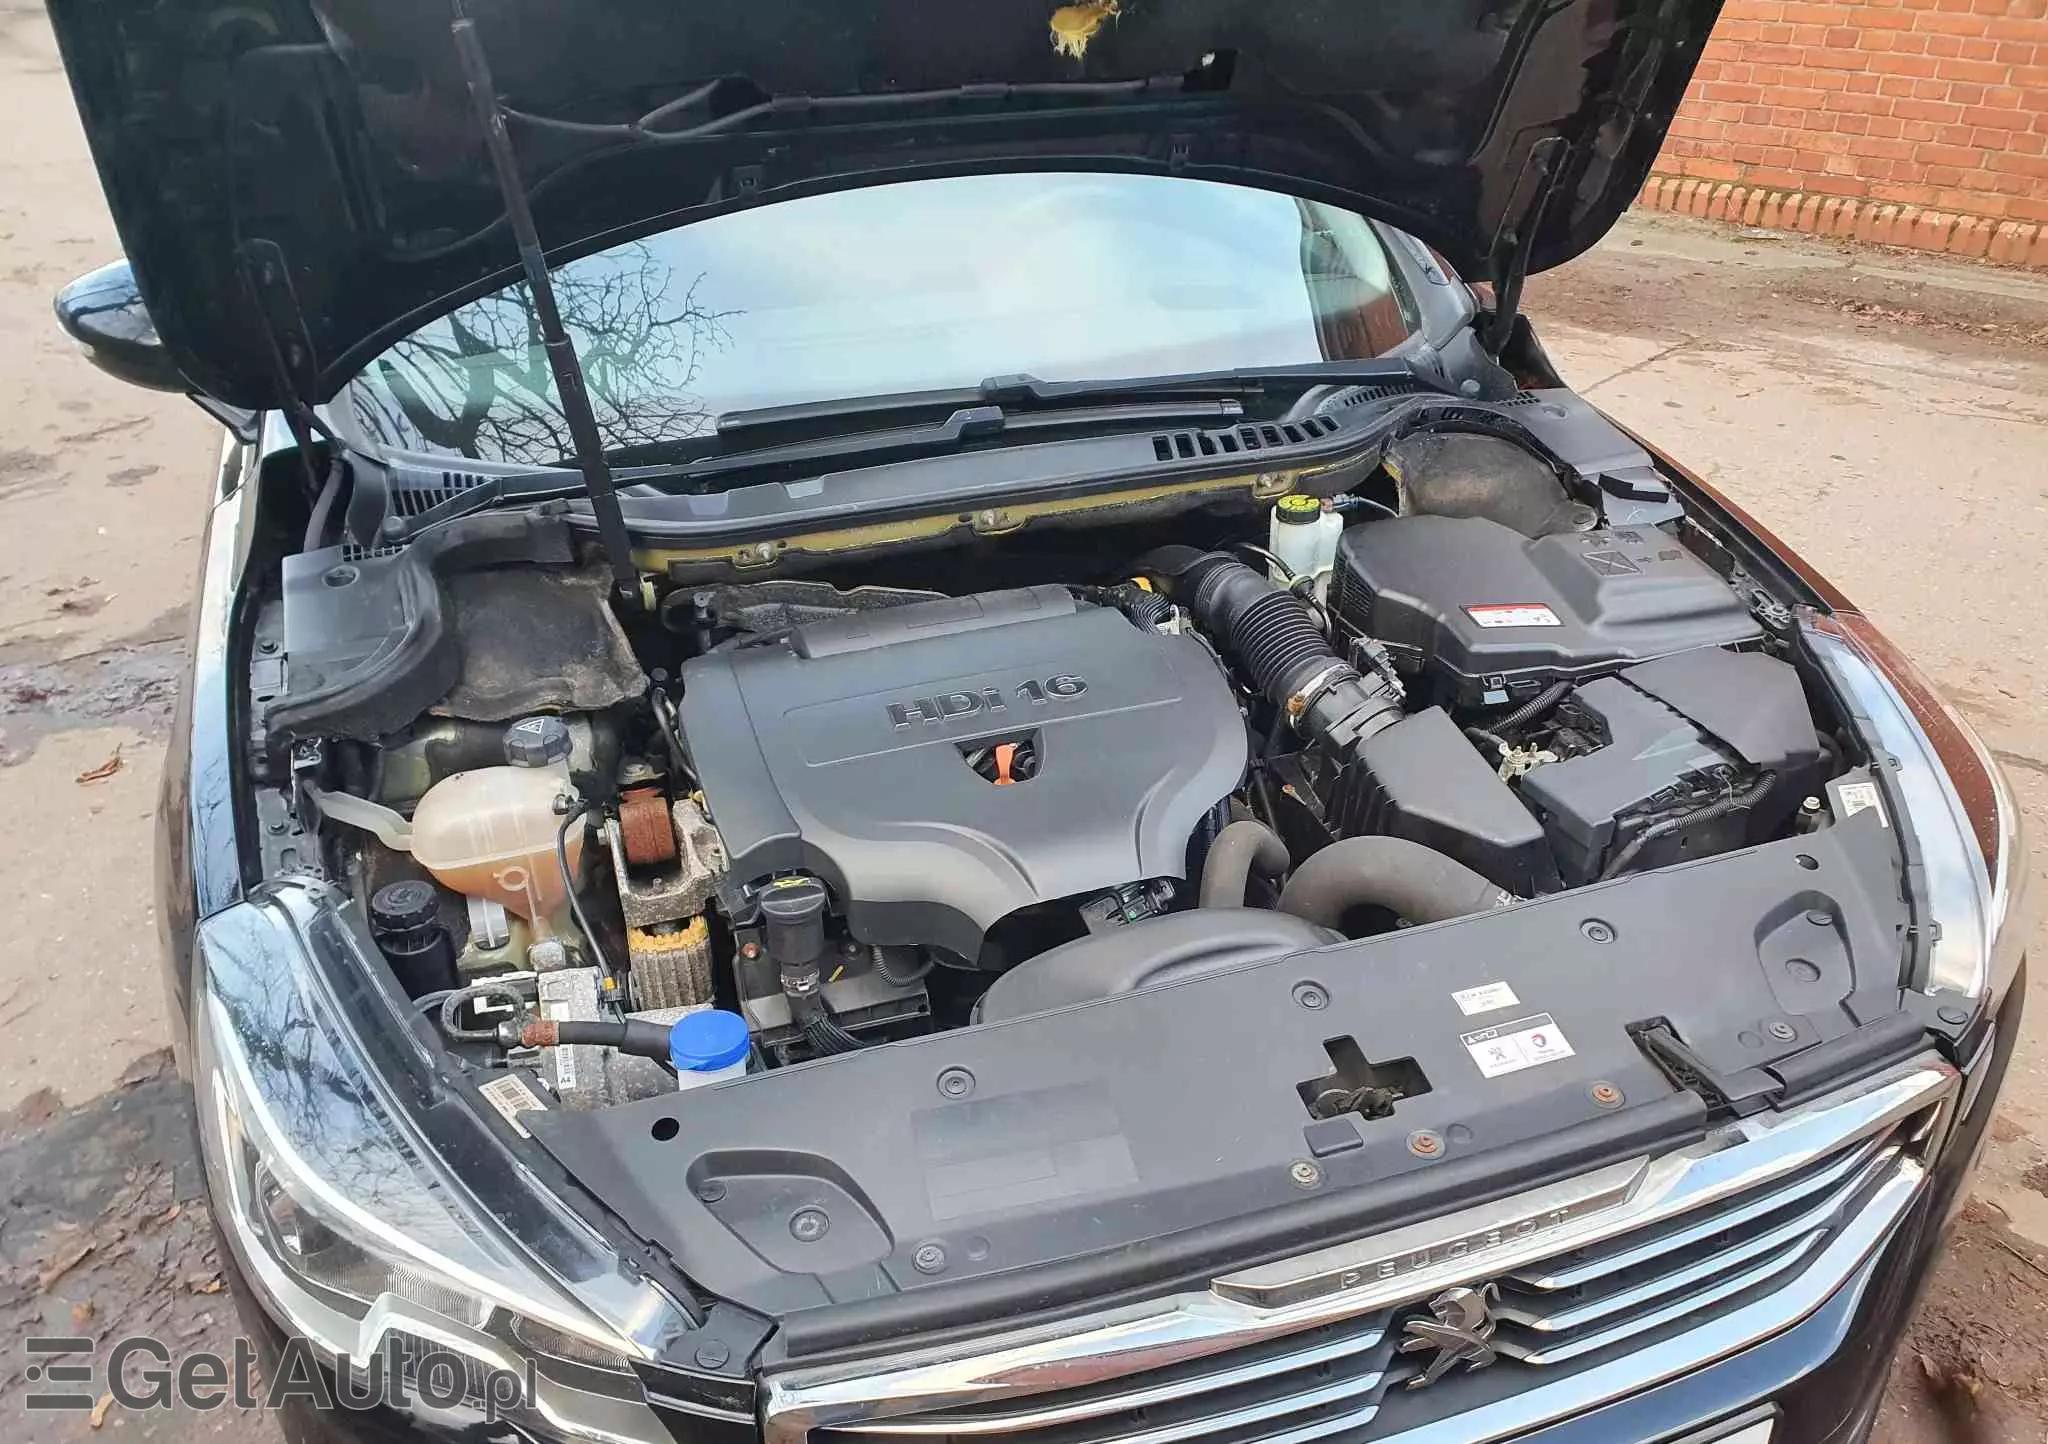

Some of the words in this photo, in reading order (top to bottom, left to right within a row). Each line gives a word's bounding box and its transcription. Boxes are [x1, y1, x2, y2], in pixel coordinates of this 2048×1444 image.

[885, 686, 1007, 731] HDi
[1015, 673, 1089, 705] 16
[1340, 1209, 1569, 1288] PEUGEOT
